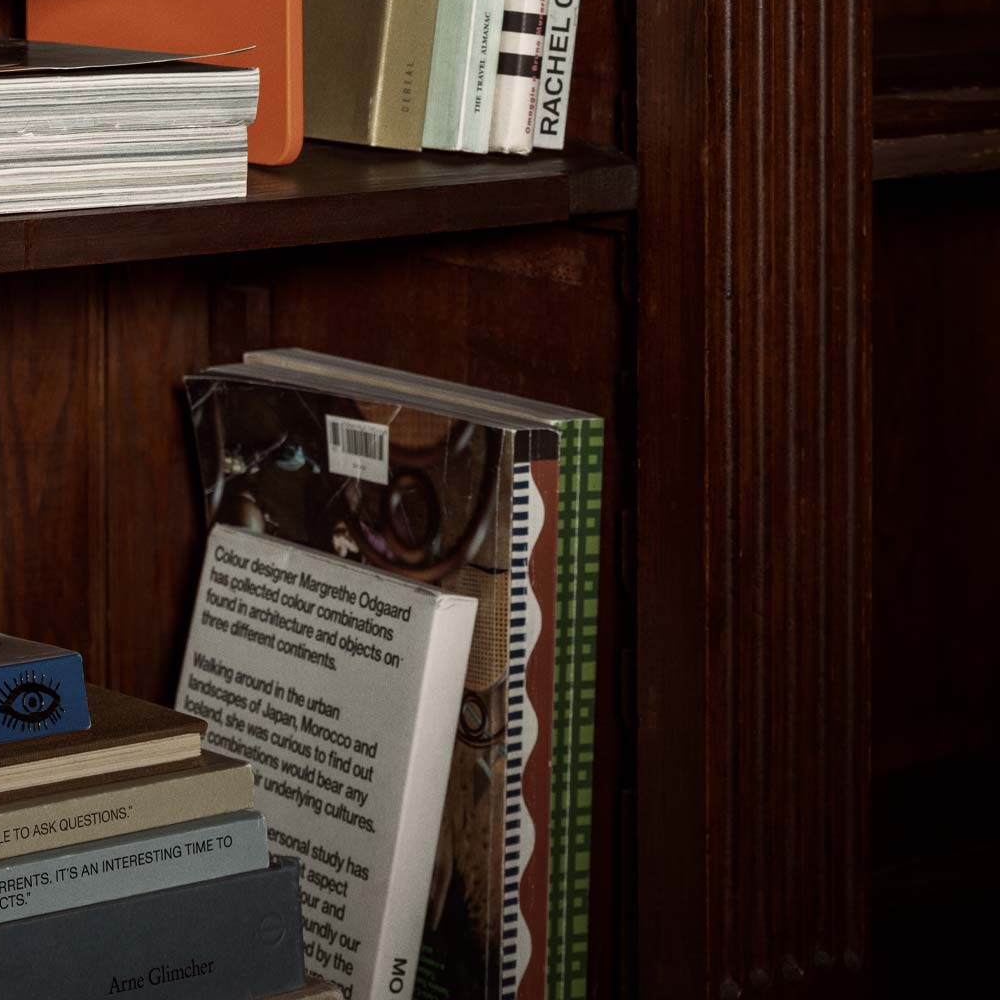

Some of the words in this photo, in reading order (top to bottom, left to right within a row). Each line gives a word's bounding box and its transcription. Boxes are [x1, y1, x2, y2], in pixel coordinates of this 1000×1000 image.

[480, 11, 492, 55] ALMANAC
[476, 55, 487, 92] TRAVEL
[540, 17, 571, 136] RACHEL
[474, 94, 482, 113] THE
[210, 566, 229, 587] has
[230, 576, 281, 604] collected
[281, 592, 316, 615] colour
[317, 605, 394, 641] combinations
[214, 545, 250, 570] Colour
[251, 557, 298, 585] designer
[299, 571, 357, 606] Margrethe
[359, 591, 412, 622] Odgaard
[201, 609, 229, 632] three
[230, 619, 276, 649] different
[276, 639, 337, 671] continents.
[206, 588, 238, 612] found
[237, 599, 248, 616] in
[248, 605, 314, 639] architecture
[315, 628, 339, 647] and
[338, 634, 382, 662] objects
[193, 651, 234, 684] Walking
[234, 671, 274, 696] around
[274, 682, 285, 700] in
[286, 687, 305, 708] the
[306, 697, 341, 721] urban
[184, 694, 223, 727] Iceland,
[225, 712, 246, 733] she
[247, 722, 269, 741] was
[270, 732, 312, 759] curious
[313, 746, 327, 764] to
[327, 750, 352, 775] find
[352, 764, 375, 783] out
[188, 673, 248, 710] landscapes
[249, 699, 263, 714] of
[262, 702, 298, 732] Japan,
[300, 715, 352, 749] Morocco
[353, 739, 379, 759] and
[206, 731, 280, 770] combinations
[281, 759, 316, 785] would
[316, 770, 345, 796] bear
[345, 785, 369, 808] any
[13, 826, 30, 841] TO
[33, 820, 57, 837] ASK
[59, 805, 134, 831] QUESTIONS."
[263, 777, 323, 815] underlying
[323, 802, 377, 834] cultures.
[55, 865, 79, 883] IT'S
[81, 861, 99, 877] AN
[102, 845, 182, 874] INTERESTING
[185, 838, 214, 856] TIME
[216, 835, 233, 850] TO
[267, 827, 311, 856] ersonal
[311, 845, 345, 873] study
[346, 856, 370, 881] has
[307, 868, 349, 898] aspect
[321, 900, 346, 921] and
[316, 943, 332, 968] by
[333, 954, 354, 976] the
[339, 934, 361, 953] our
[109, 976, 145, 995] Arne
[148, 958, 215, 986] Glimcher
[389, 957, 408, 994] MO
